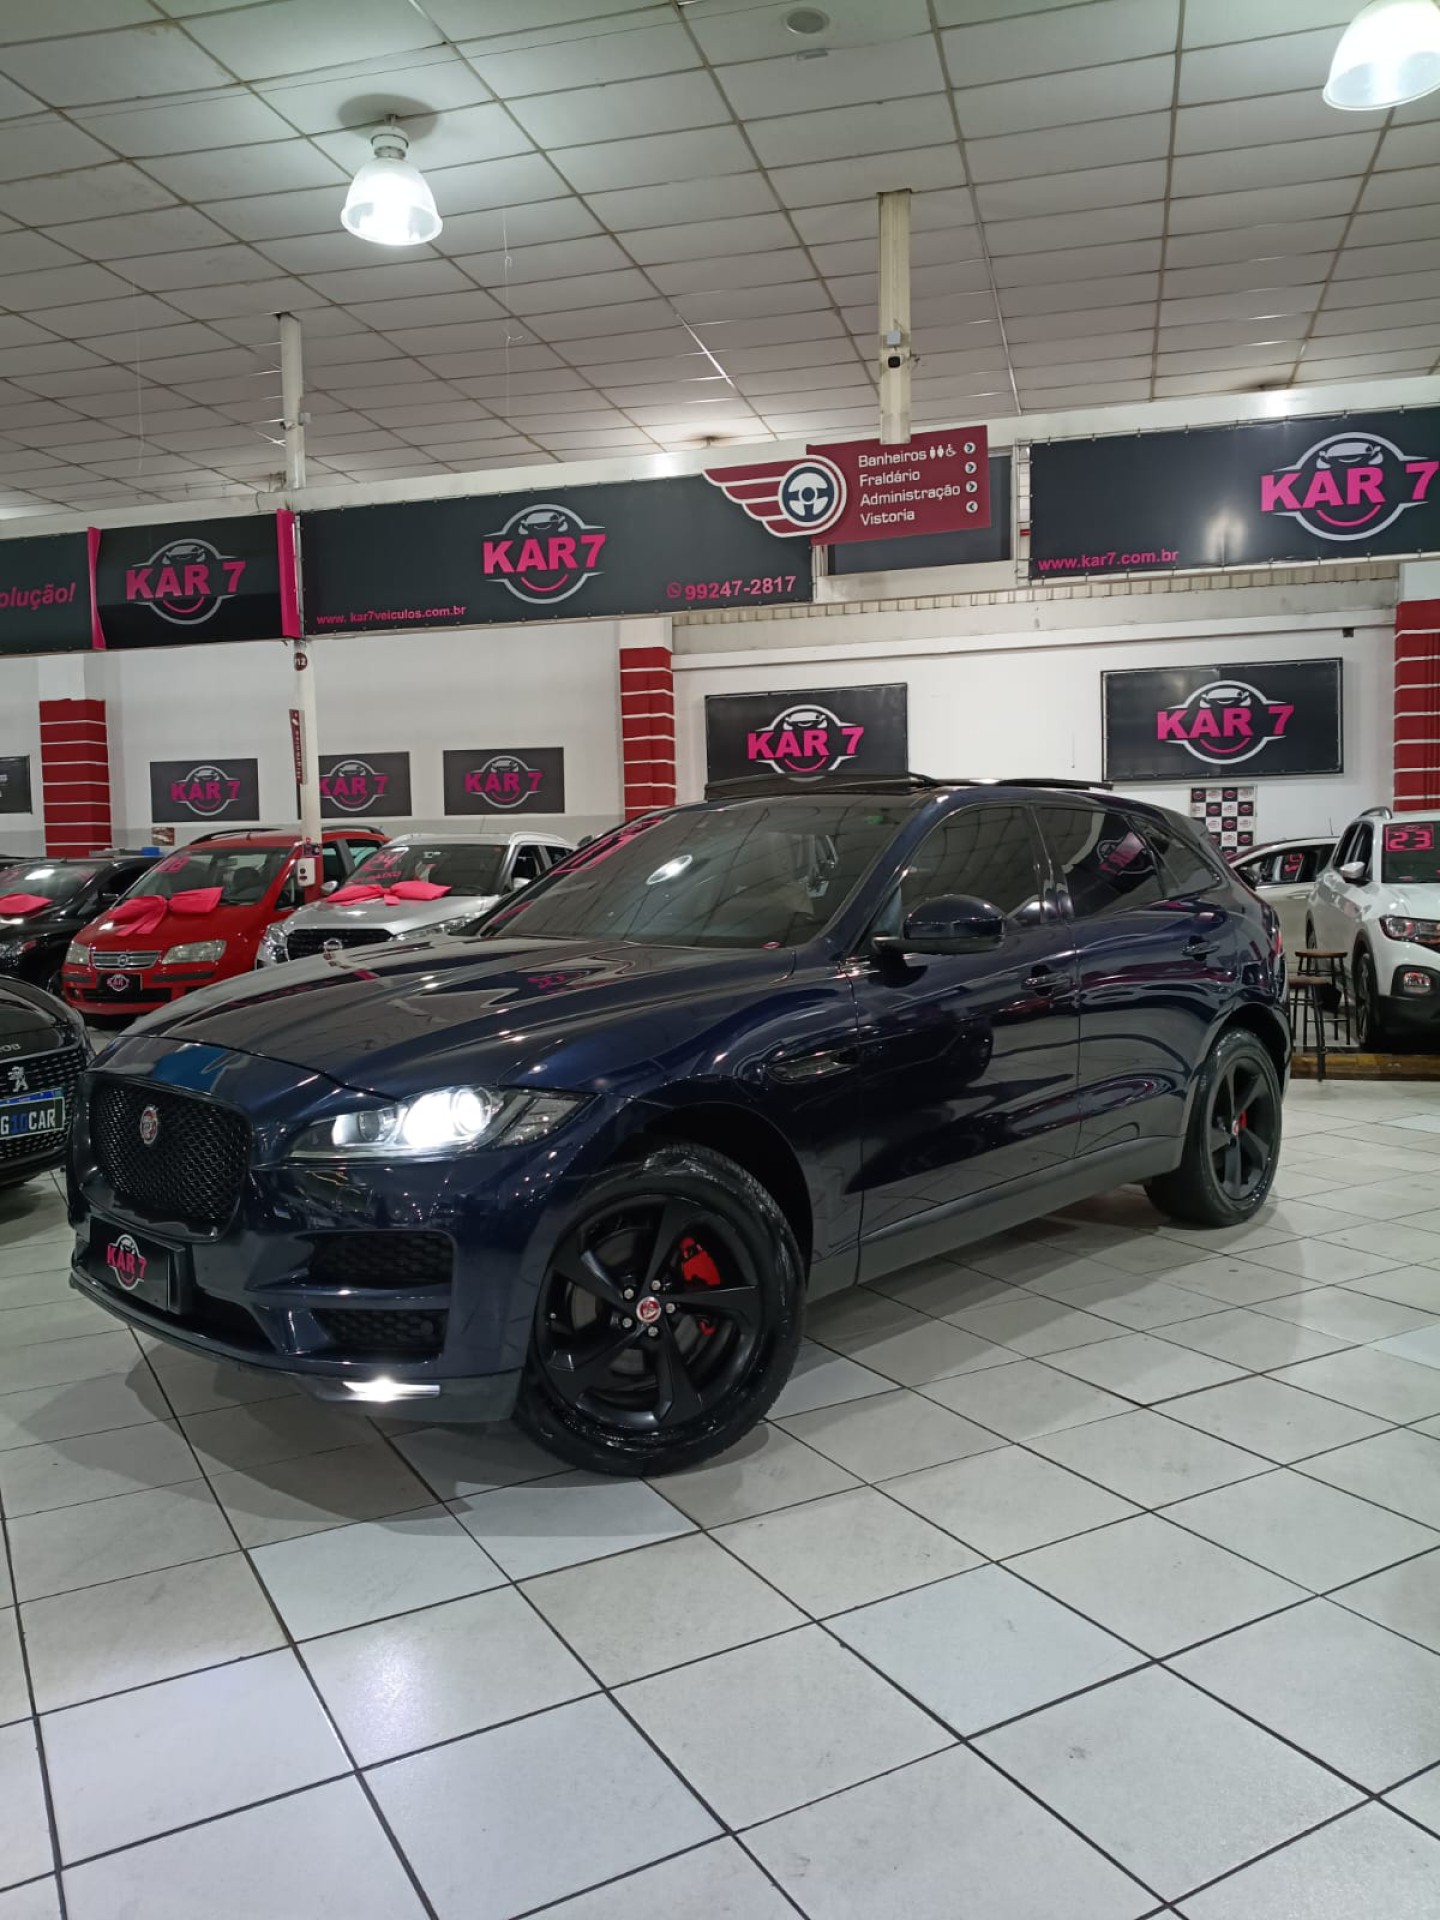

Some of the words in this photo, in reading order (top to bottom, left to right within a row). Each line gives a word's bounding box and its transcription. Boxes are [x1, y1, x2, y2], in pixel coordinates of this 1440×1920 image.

[858, 450, 927, 468] Banheiros
[860, 469, 920, 487] Fraldário
[1261, 467, 1386, 512] KAR
[1405, 461, 1440, 501] 7
[860, 484, 961, 507] Administração
[860, 509, 915, 526] Vistoria
[1038, 549, 1179, 570] www.kar7.com.br
[126, 564, 211, 601] KAR
[222, 561, 246, 593] 7
[684, 575, 797, 601] 99247-2817
[1157, 707, 1254, 740] KAR
[1268, 704, 1295, 735] 7
[747, 729, 830, 760] KAR
[841, 726, 864, 755] 7
[170, 781, 222, 801] KAR
[226, 780, 241, 799] 7
[373, 774, 389, 795] 7
[464, 771, 521, 794] KAR
[526, 770, 543, 791] 7
[1389, 829, 1431, 849] 23
[106, 1245, 135, 1275] KAR
[138, 1257, 148, 1279] 7
